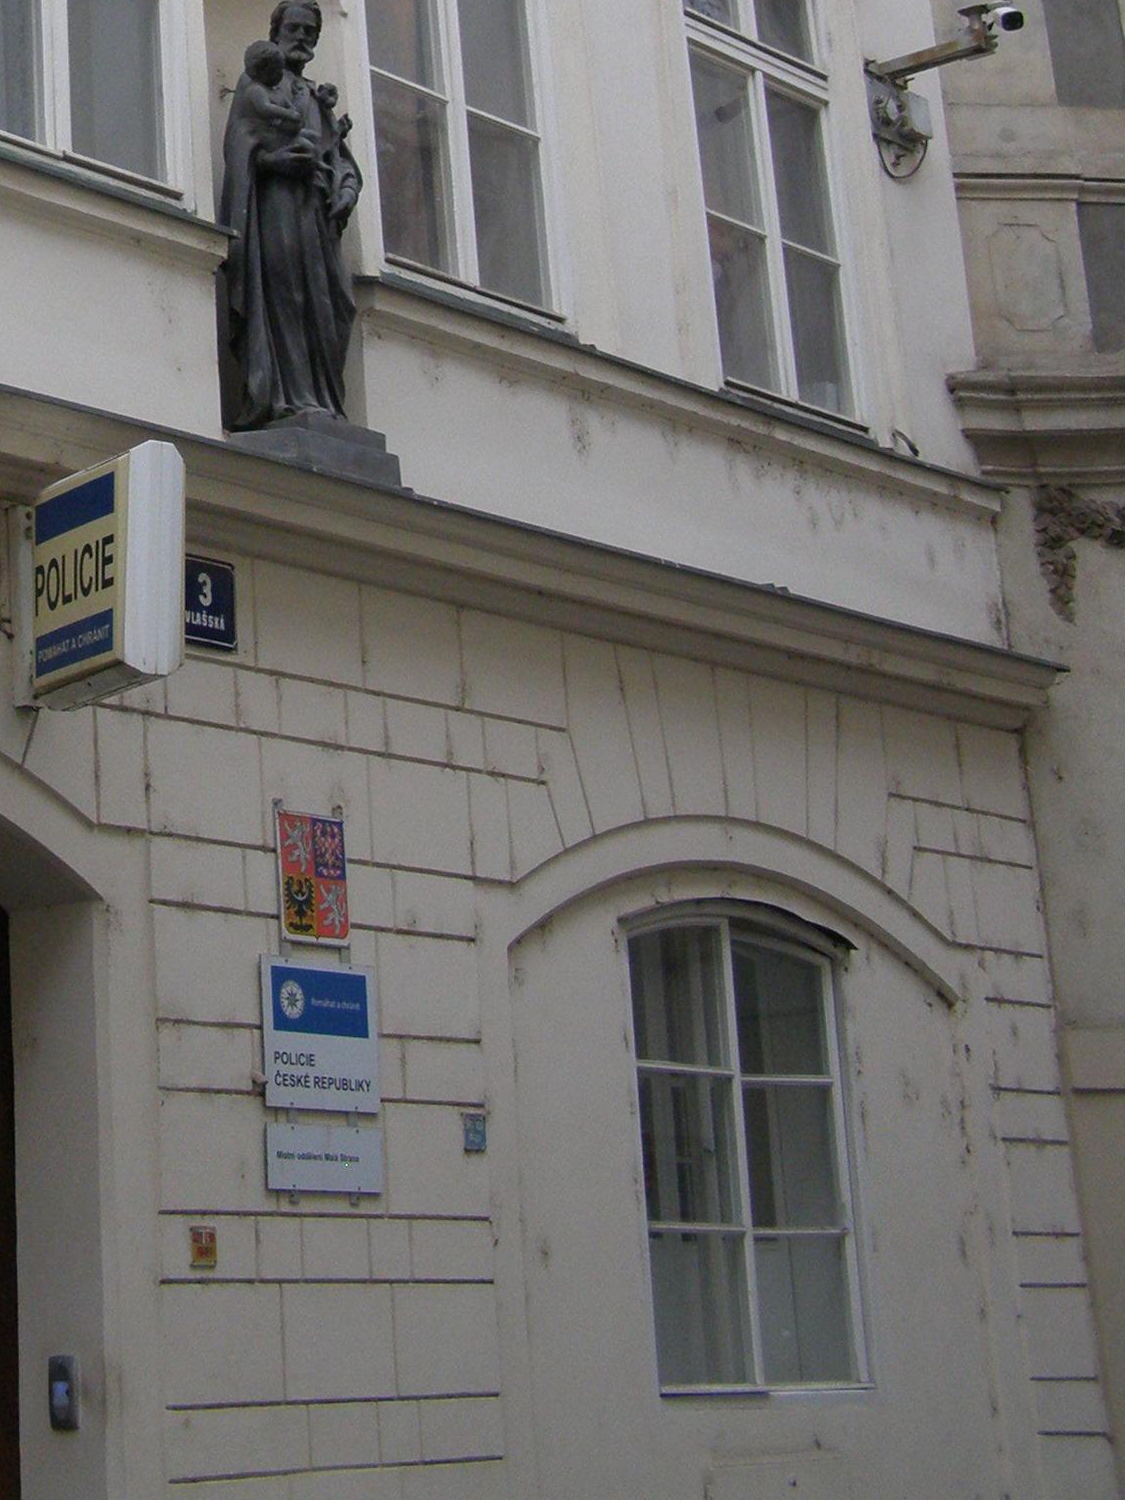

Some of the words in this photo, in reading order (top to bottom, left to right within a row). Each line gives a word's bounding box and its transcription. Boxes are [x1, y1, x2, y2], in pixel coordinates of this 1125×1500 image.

[35, 533, 115, 617] POLICIE
[197, 572, 213, 607] 3
[274, 1050, 316, 1067] POLICIE
[275, 1069, 311, 1089] ČESKÉ
[313, 1075, 372, 1093] REPUBLIKY
